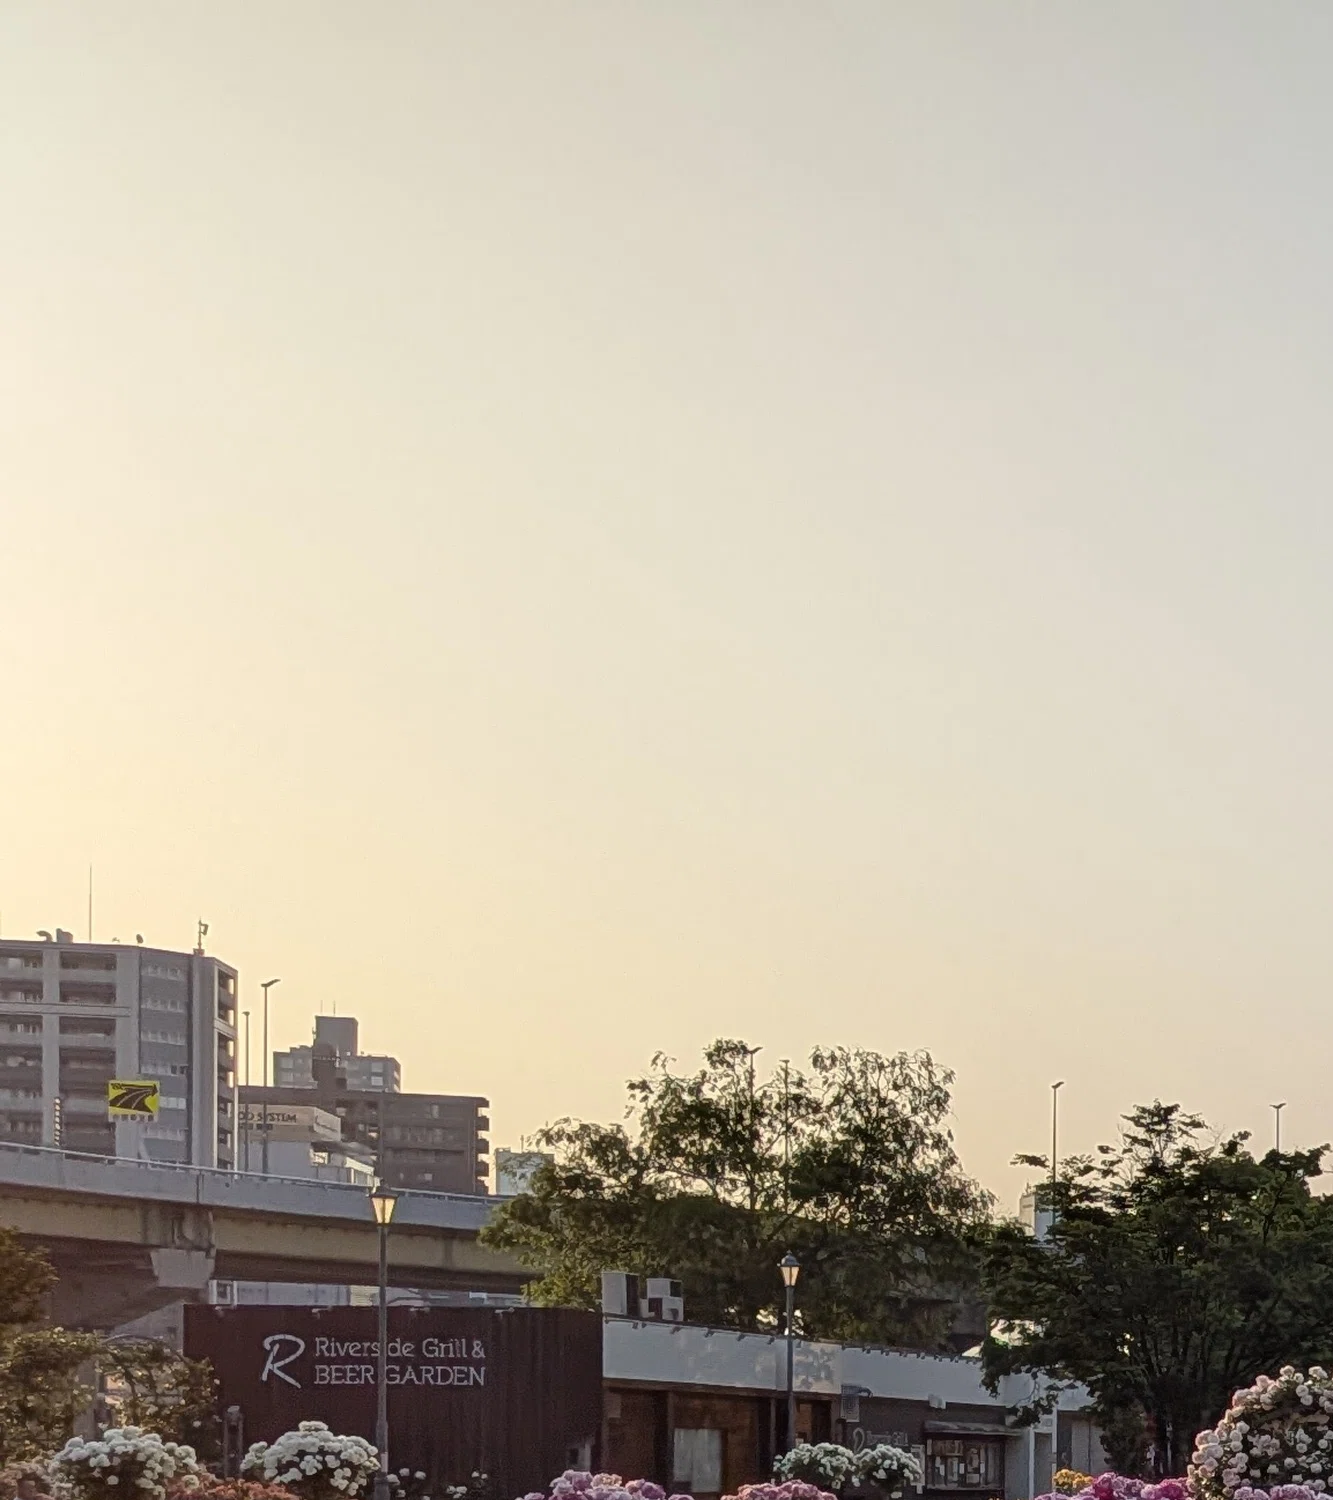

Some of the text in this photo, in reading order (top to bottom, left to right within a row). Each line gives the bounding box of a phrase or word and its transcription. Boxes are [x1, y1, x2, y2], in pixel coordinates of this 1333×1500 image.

[315, 1336, 486, 1359] Riversde Grill &
[261, 1333, 306, 1389] R
[314, 1364, 486, 1386] BEER GARDEN
